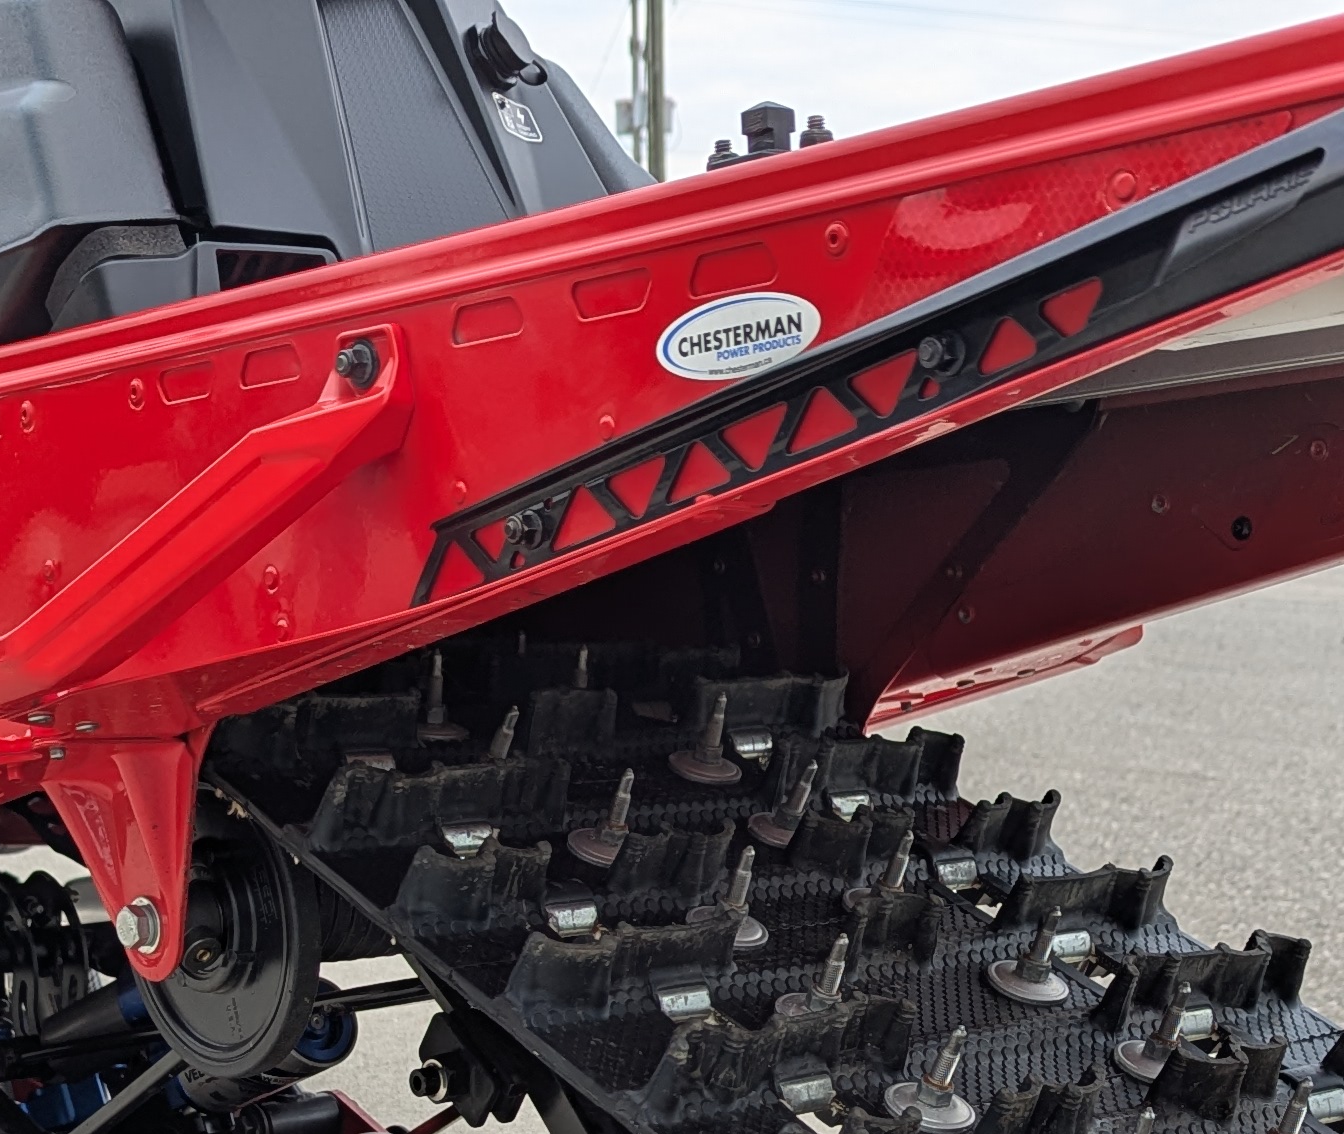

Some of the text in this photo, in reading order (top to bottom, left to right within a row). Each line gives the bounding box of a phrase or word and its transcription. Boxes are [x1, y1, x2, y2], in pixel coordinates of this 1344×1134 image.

[678, 312, 803, 358] CHESTERMAN
[716, 334, 802, 362] POWER PRODUCTS
[708, 357, 773, 376] www.chesterman.ca
